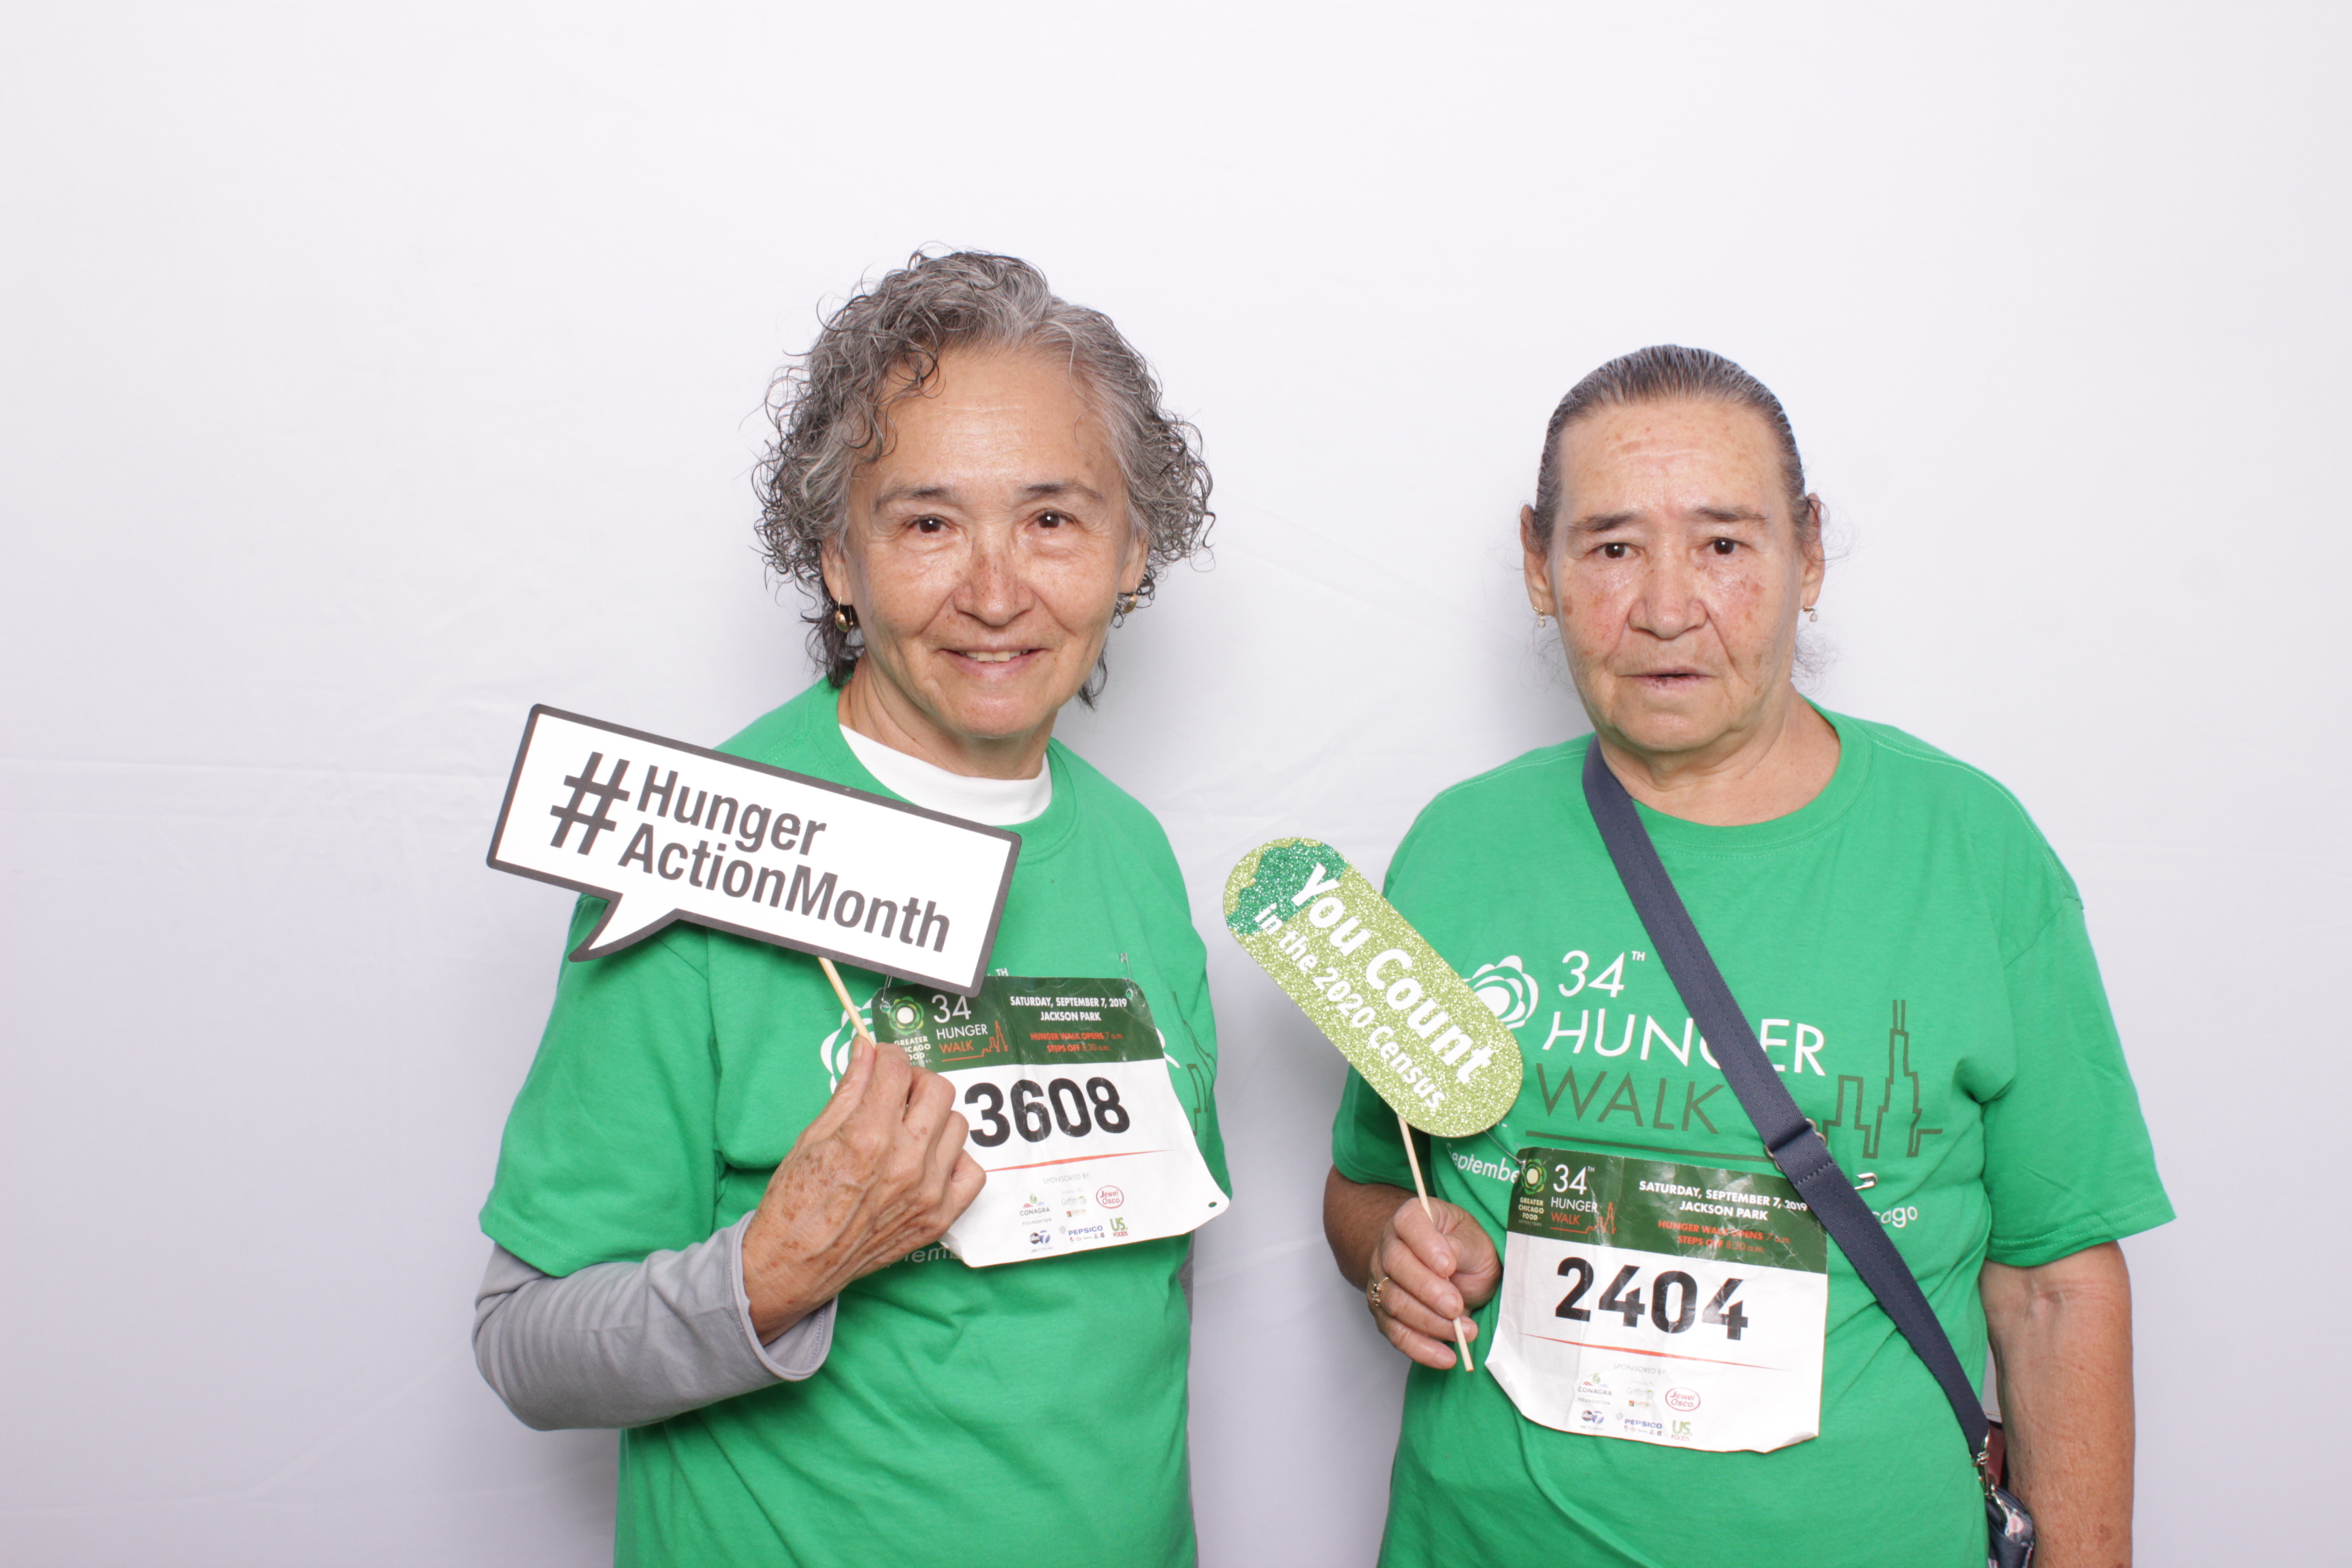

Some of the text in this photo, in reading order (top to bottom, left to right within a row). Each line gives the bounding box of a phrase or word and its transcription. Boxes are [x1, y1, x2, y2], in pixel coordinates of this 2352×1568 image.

[618, 823, 951, 952] ActionMonth
[1290, 862, 1494, 1084] You Count
[1010, 996, 1128, 1009] SATURDAY, SEPTEMBER 7, 2019
[1254, 903, 1446, 1108] in the 2020 Census
[1041, 1011, 1102, 1021] JACKSON PARK
[936, 1024, 988, 1040] HUNGER
[1030, 1032, 1060, 1041] HUNGER
[1081, 1032, 1105, 1040] OPENS
[894, 1036, 928, 1046] GREATER
[902, 1043, 931, 1053] ICAGO
[939, 1040, 975, 1054] WALK
[1067, 1044, 1081, 1052] OFF
[1536, 1062, 1725, 1135] WALK
[964, 1077, 1130, 1147] 3608
[1043, 1173, 1081, 1184] SPONSORED
[1100, 1190, 1118, 1198] Jewel
[1639, 1181, 1809, 1211] SATURDAY, SEPTEMBER 7, 2019
[1520, 1197, 1544, 1207] GREATER
[1551, 1196, 1599, 1213] HUNGER
[1019, 1207, 1051, 1216] CONAGRA
[1518, 1205, 1544, 1214] CHICAGO
[1679, 1200, 1768, 1221] JACKSON PARK
[1022, 1218, 1052, 1226] FOUNDATION
[1522, 1212, 1538, 1221] FOOD
[1551, 1211, 1581, 1225] WALK
[1068, 1225, 1103, 1236] PEPSICO
[1658, 1220, 1700, 1233] HUNGER
[1701, 1225, 1729, 1237] WALK
[1731, 1229, 1764, 1241] OPENS
[1678, 1235, 1704, 1247] STEPS
[1554, 1257, 1749, 1341] 2404
[1613, 1363, 1656, 1375] SPONSORED
[1578, 1386, 1612, 1396] CONAGRA
[1670, 1391, 1695, 1401] Jewel
[1578, 1397, 1611, 1405] FOUNDATION
[1671, 1399, 1694, 1408] Osco
[1624, 1418, 1663, 1429] PEPSICO
